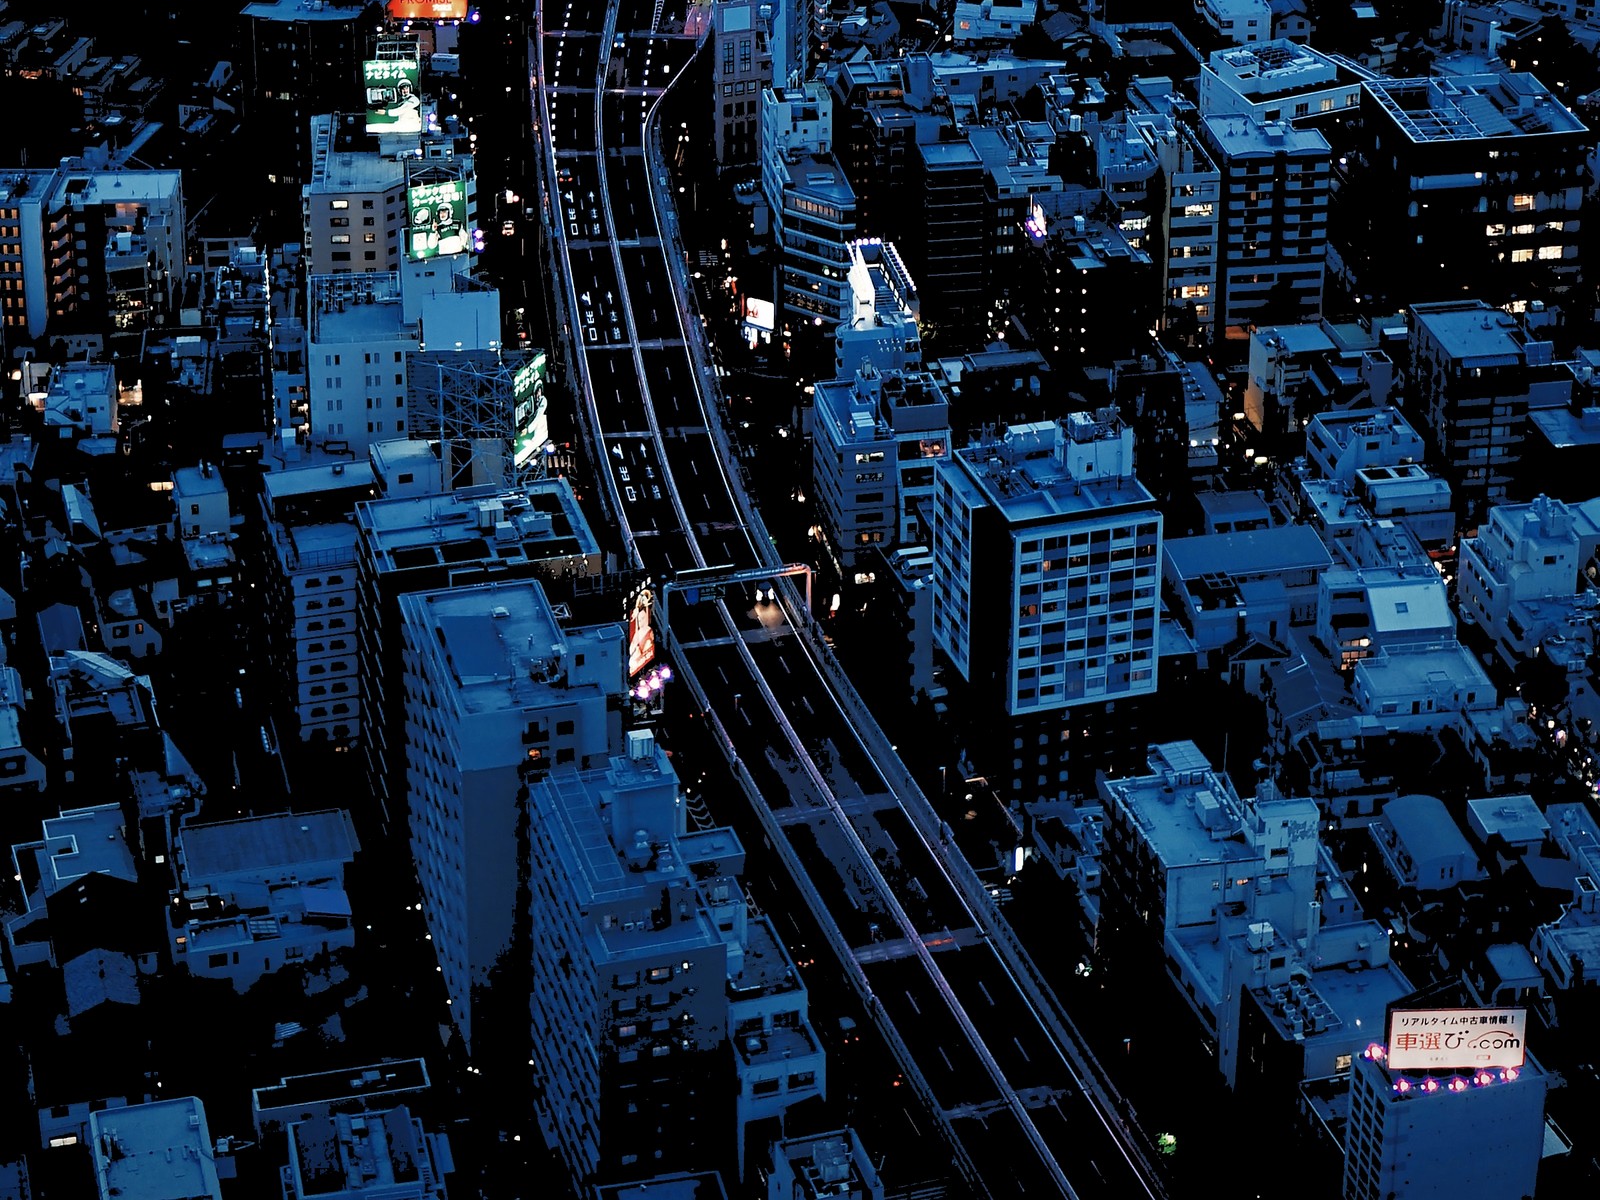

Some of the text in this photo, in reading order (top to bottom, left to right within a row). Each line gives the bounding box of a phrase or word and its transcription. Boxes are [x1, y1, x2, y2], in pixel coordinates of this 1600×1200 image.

[365, 70, 407, 80] ナビタイム
[568, 208, 579, 236] 出口
[586, 310, 598, 341] 出口
[618, 466, 637, 502] 出口
[1401, 1015, 1515, 1026] リアルタイム中古車情報！
[1396, 1031, 1520, 1051] 車選び.com
